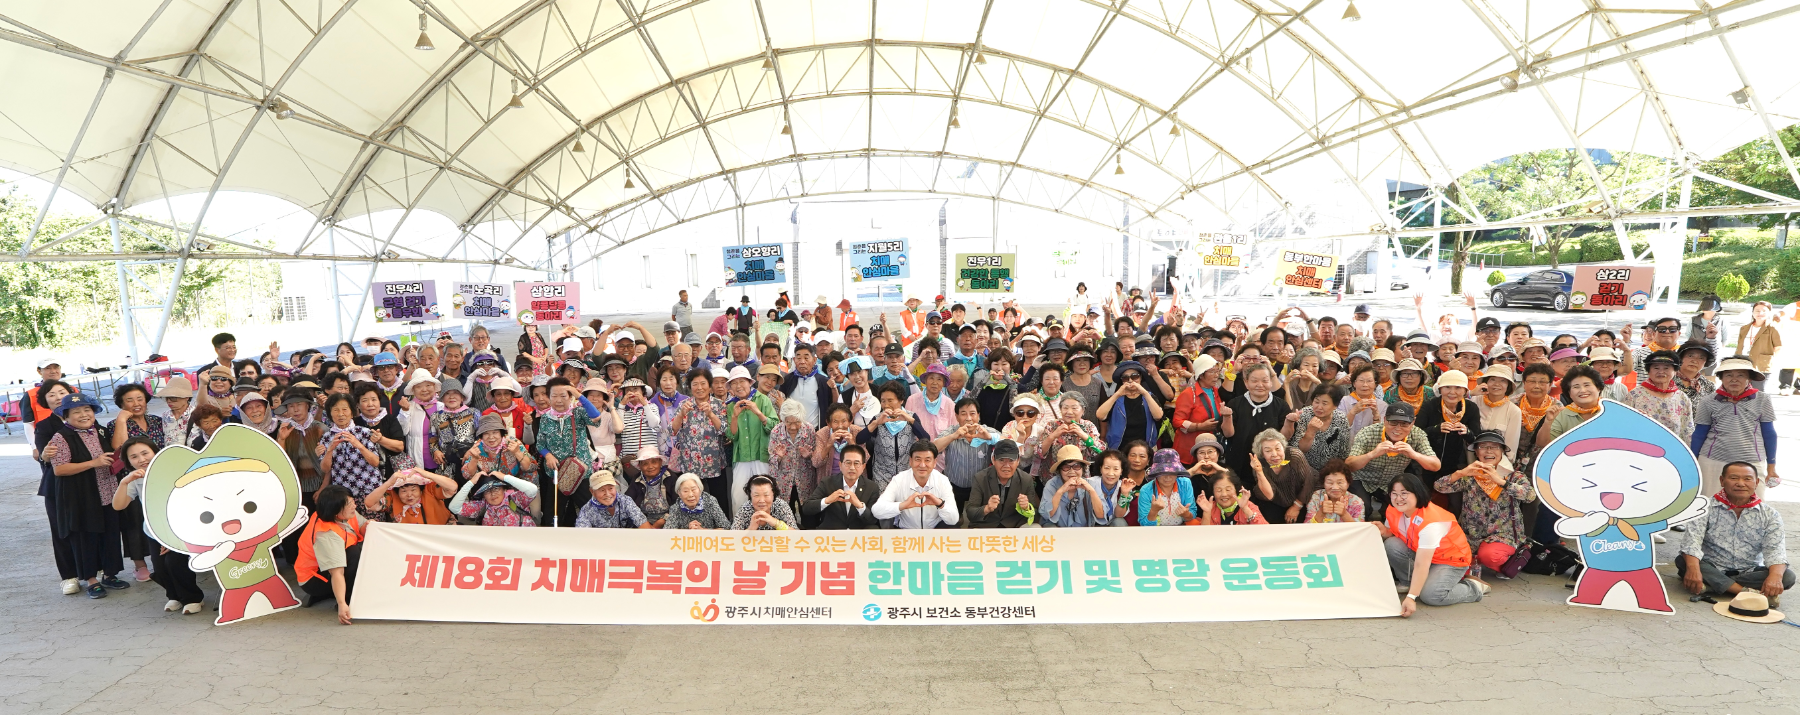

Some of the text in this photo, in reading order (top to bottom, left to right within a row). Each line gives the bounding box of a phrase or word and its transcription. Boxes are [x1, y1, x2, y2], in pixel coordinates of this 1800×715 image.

[867, 240, 903, 253] 지월5리
[1213, 245, 1233, 255] 치매
[744, 259, 765, 271] 치매
[870, 255, 890, 266] 치매
[967, 256, 1002, 267] 진우1리
[1204, 255, 1240, 266] 안심마을
[737, 269, 775, 283] 안심마을
[862, 265, 900, 278] 안심마을
[961, 268, 1010, 279] 건강한 동행
[1295, 265, 1316, 277] 치매
[971, 279, 999, 289] 동아리
[1285, 274, 1323, 289] 안심센터
[385, 282, 424, 295] 진우4리
[474, 285, 503, 296] 노곡리
[1598, 283, 1624, 294] 걷기
[405, 295, 426, 306] 걷기
[473, 296, 492, 307] 치매
[1590, 294, 1628, 306] 동아리
[464, 306, 500, 317] 안심마을
[536, 311, 562, 321] 동아리
[670, 535, 1056, 554] 치매여도 안심할 수 있는 사회, 함께 사는 따뜻한 세상
[1589, 539, 1636, 554] Cleany
[400, 554, 1345, 596] 제18회 치매극복의 날 기념 한마음 걷기 및 명랑 운동회
[886, 605, 1037, 620] 광주시 보건소 동부건강센터
